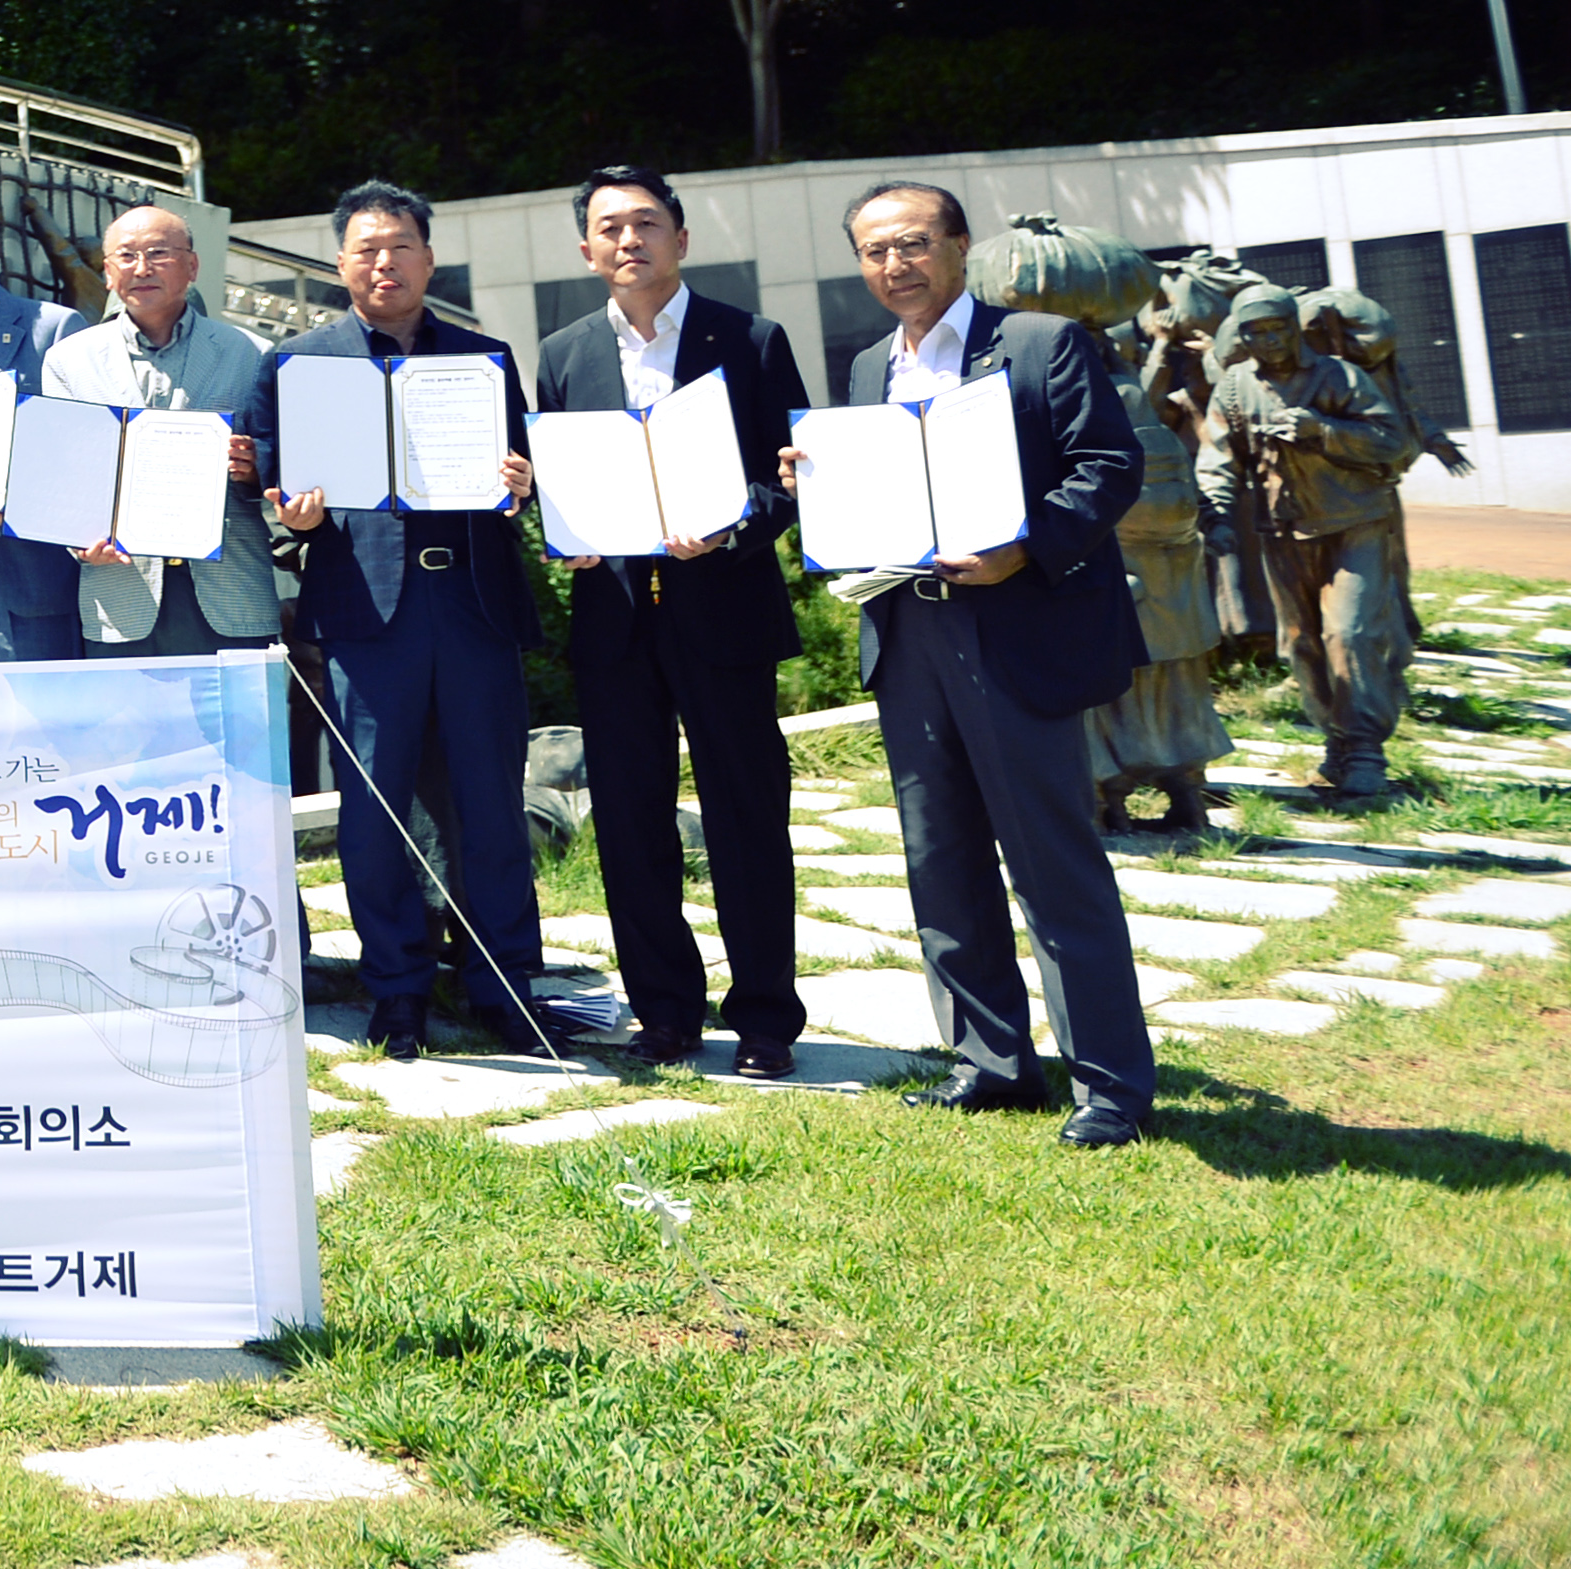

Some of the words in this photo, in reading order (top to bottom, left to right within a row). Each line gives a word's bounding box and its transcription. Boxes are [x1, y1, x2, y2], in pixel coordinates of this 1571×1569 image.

[6, 755, 60, 783] 가는
[33, 783, 224, 879] 거제!
[144, 850, 216, 865] GEOJE
